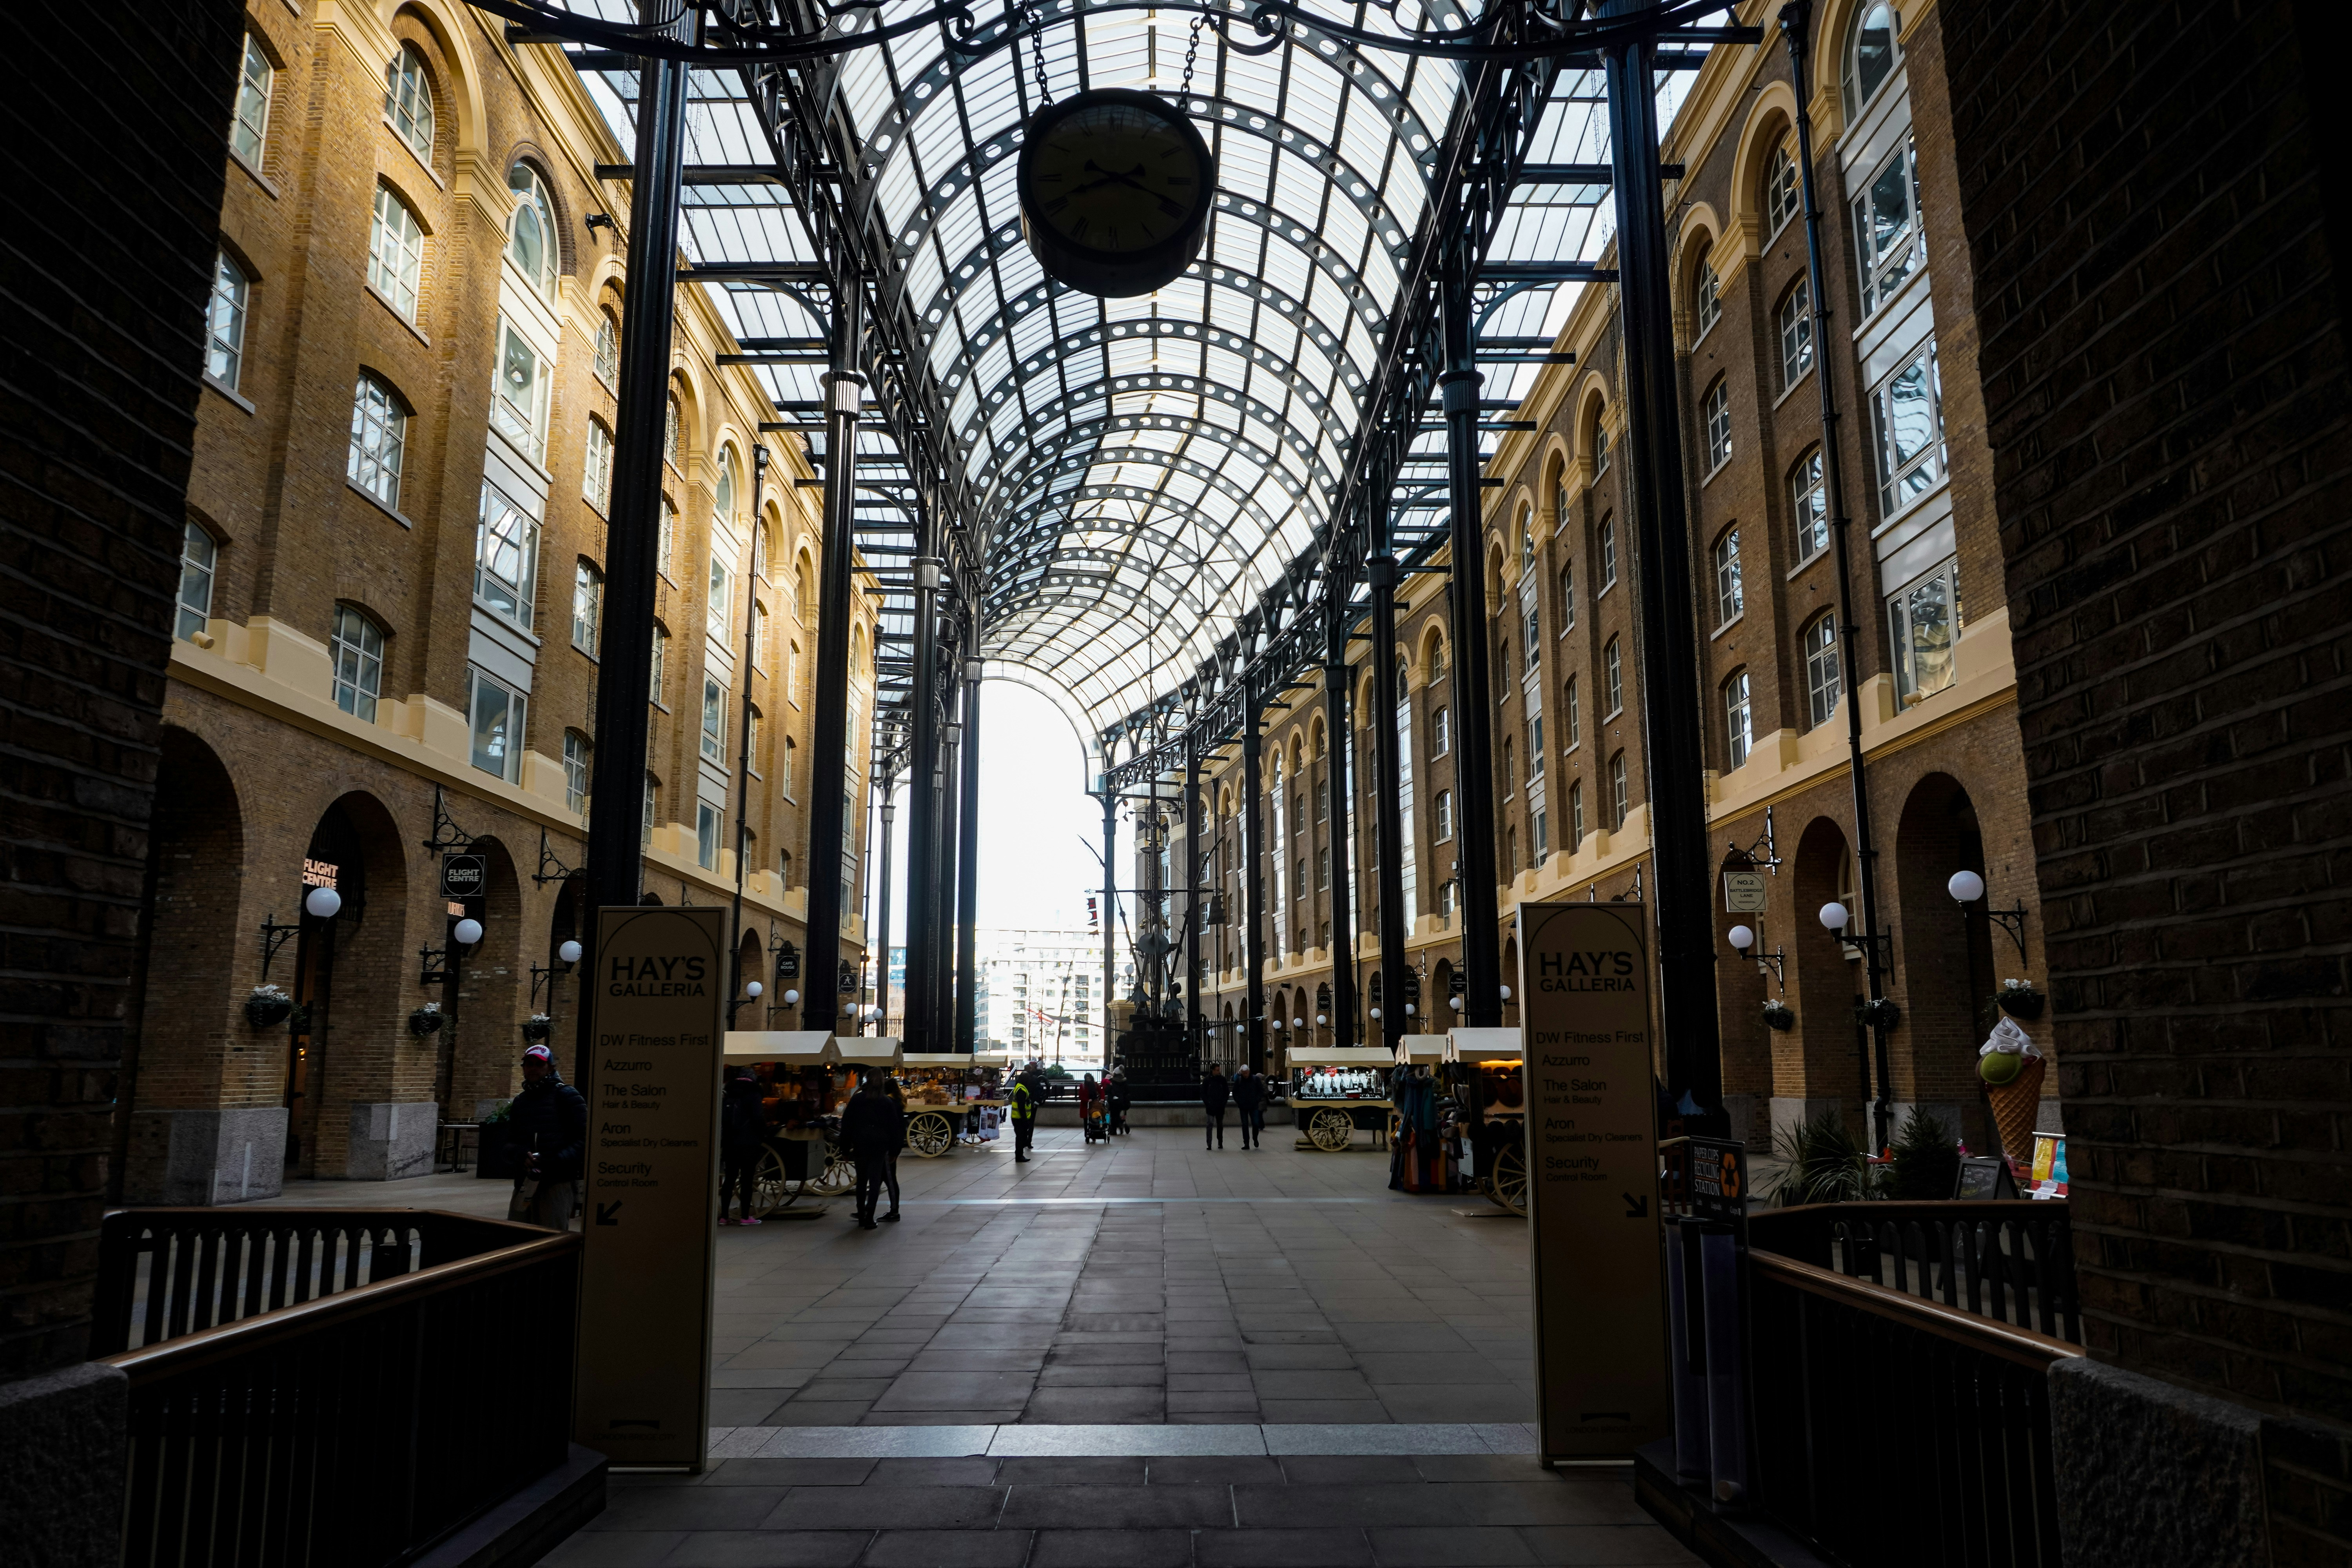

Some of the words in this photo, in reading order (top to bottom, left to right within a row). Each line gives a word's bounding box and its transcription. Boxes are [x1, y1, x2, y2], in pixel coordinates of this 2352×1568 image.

[304, 858, 339, 878] FLIGHT
[302, 871, 337, 890] CENTRE
[611, 956, 706, 980] HAY'S
[1540, 951, 1633, 976] HAY'S
[609, 983, 706, 996] GALLERIA
[1540, 978, 1636, 992] GALLERIA
[601, 1034, 625, 1046] DW
[628, 1034, 676, 1046] Fitness
[680, 1034, 708, 1045] First
[1536, 1032, 1560, 1044] DW
[1564, 1031, 1612, 1044] Fitness
[1616, 1031, 1644, 1043] First
[604, 1059, 652, 1071] Azzurro
[1542, 1054, 1590, 1066] Azzurro
[603, 1084, 627, 1096] The
[631, 1084, 666, 1096] Salon
[1543, 1079, 1567, 1091] The
[1571, 1079, 1606, 1091] Salon
[602, 1101, 620, 1109] Hair
[631, 1100, 661, 1111] Beauty
[1544, 1096, 1561, 1104] Hair
[1563, 1096, 1570, 1104] &
[1572, 1095, 1602, 1105] Beauty
[601, 1122, 631, 1134] Aron
[1544, 1118, 1575, 1129] Aron
[600, 1138, 641, 1148] Specialist
[643, 1138, 659, 1149] Dry
[660, 1138, 698, 1147] Cleaners
[1546, 1133, 1586, 1143] Specialist
[1588, 1133, 1603, 1143] Dry
[1605, 1133, 1643, 1142] Cleaners
[1694, 1146, 1707, 1159] PAPER
[1708, 1148, 1719, 1161] CUPS
[598, 1161, 652, 1176] Security
[1545, 1156, 1600, 1171] Security
[1694, 1160, 1720, 1180] RECYCLING
[596, 1178, 629, 1187] Control
[631, 1178, 659, 1187] Room
[1546, 1173, 1578, 1182] Control
[1581, 1173, 1608, 1181] Room
[1695, 1179, 1720, 1196] STATION
